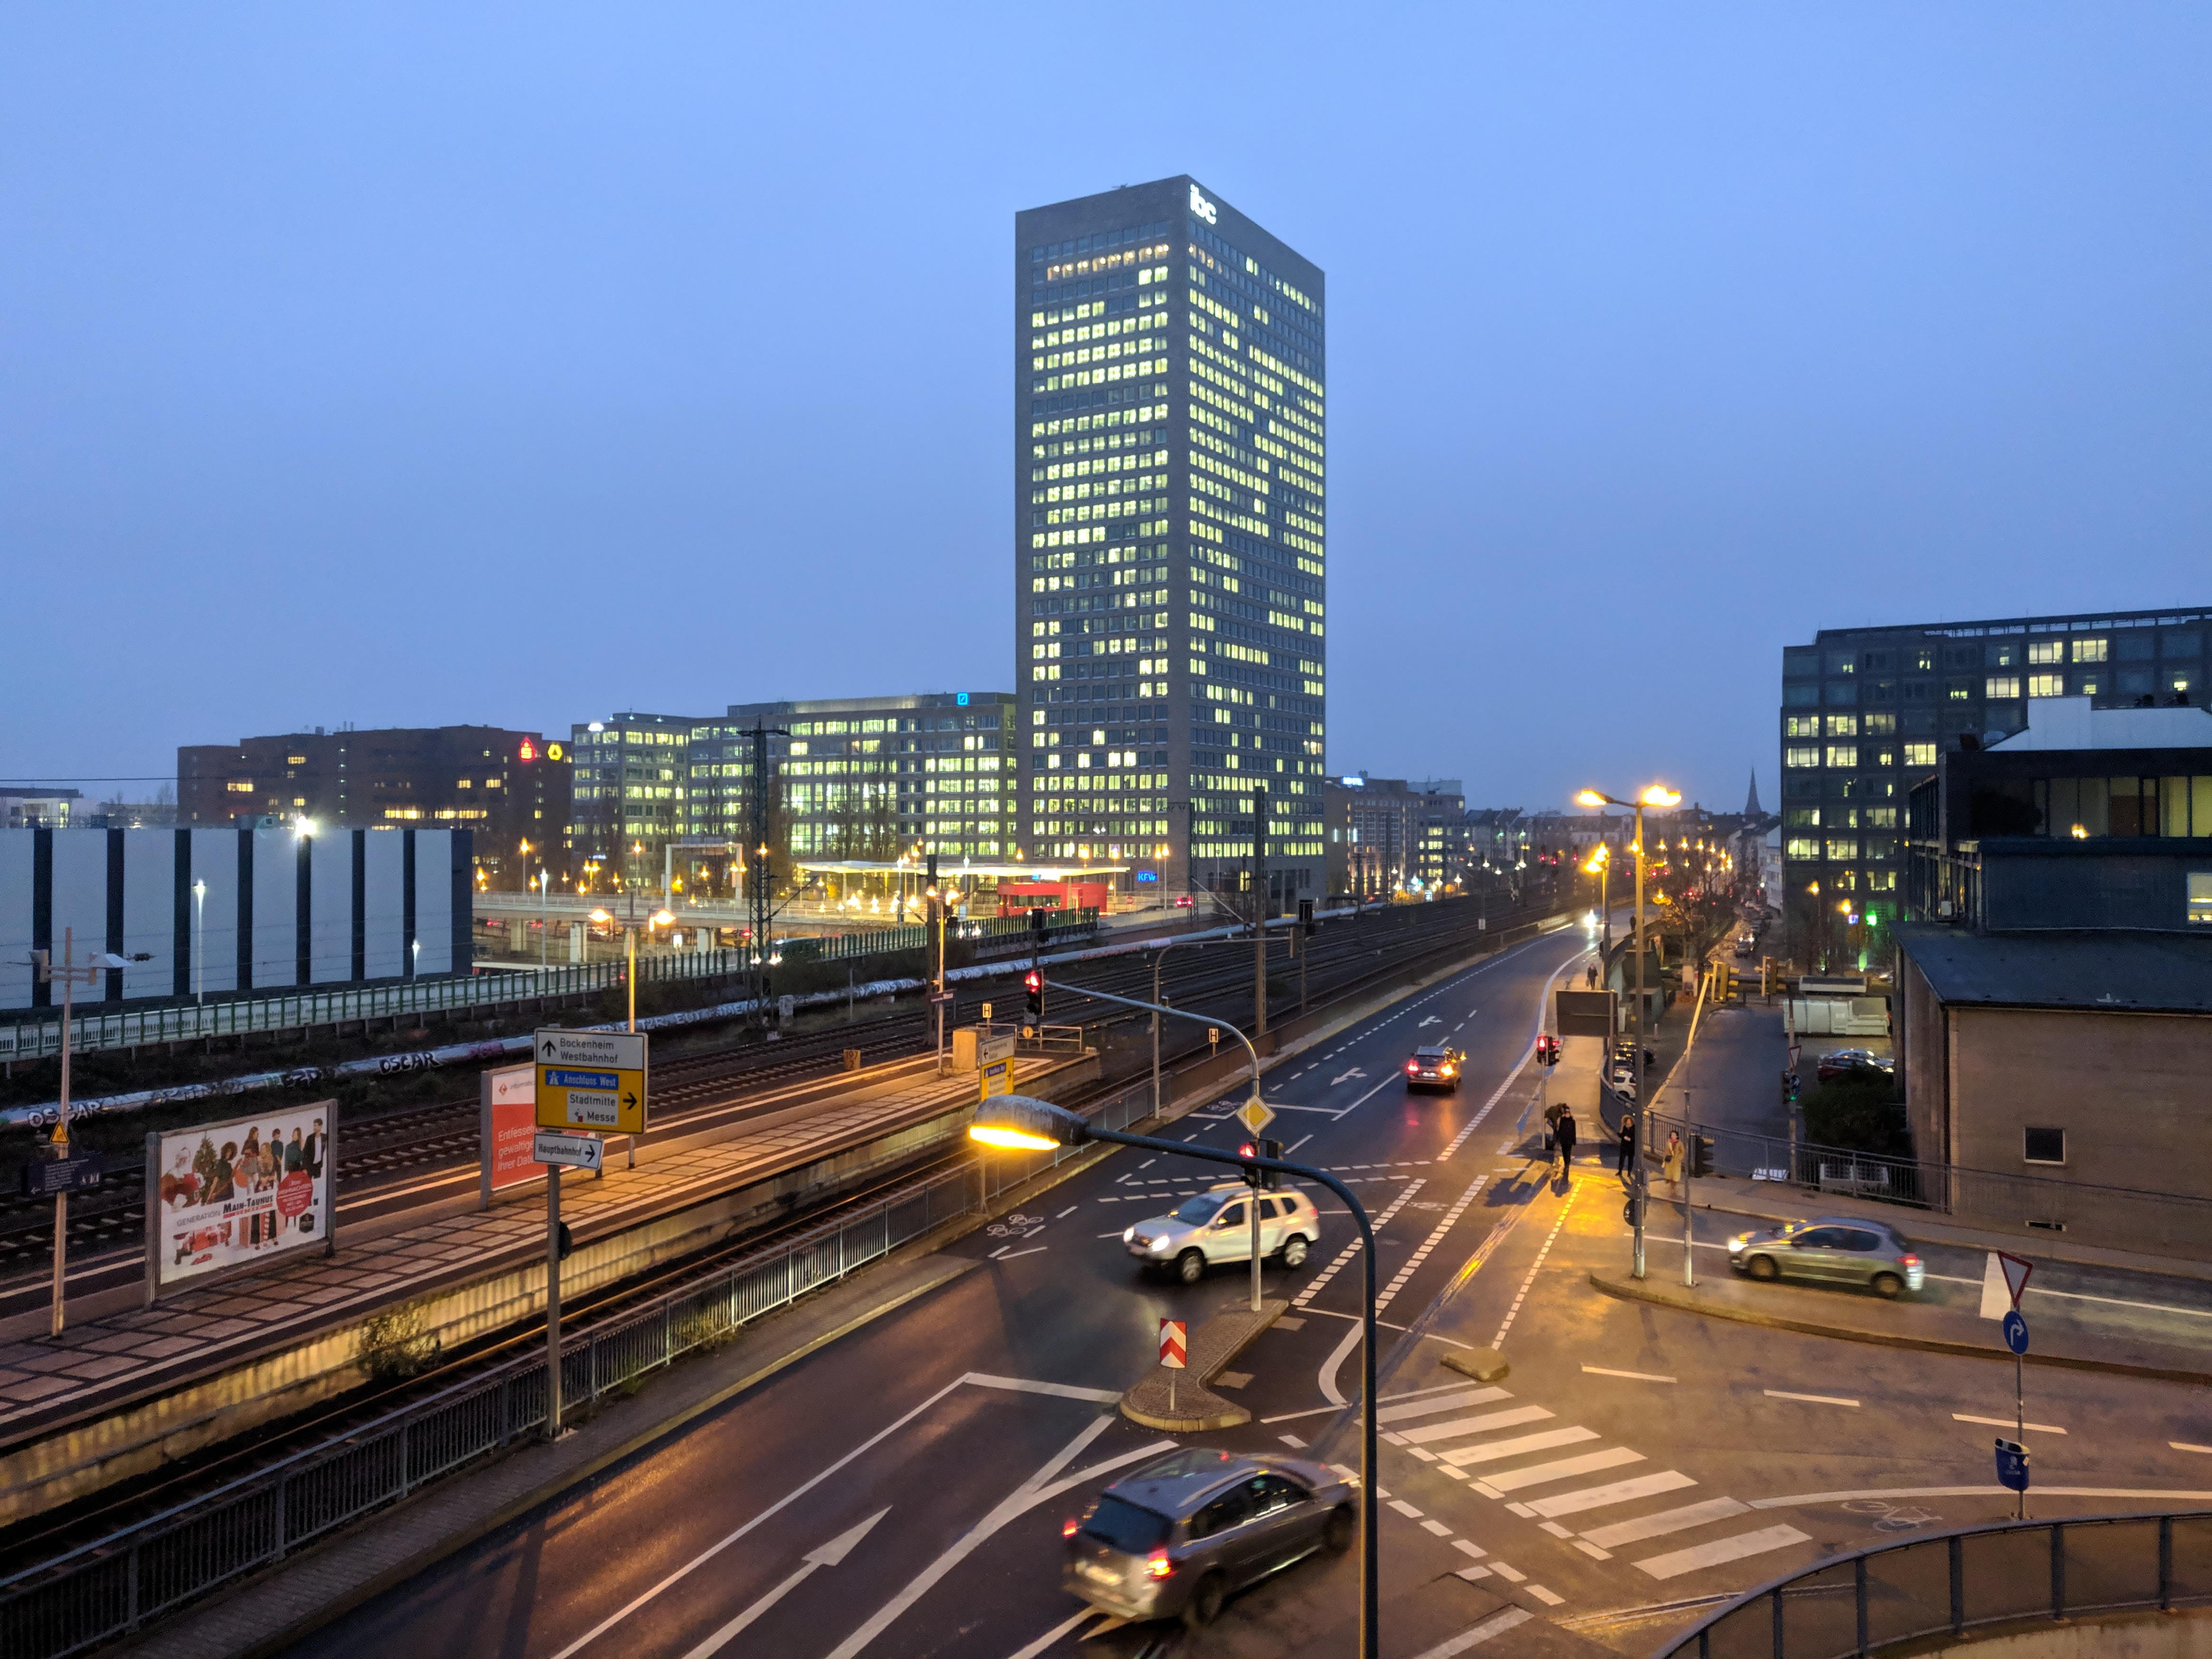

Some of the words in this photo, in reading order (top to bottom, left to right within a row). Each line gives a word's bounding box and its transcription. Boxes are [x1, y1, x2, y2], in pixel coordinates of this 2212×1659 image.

[1190, 183, 1217, 225] ibc
[984, 1005, 990, 1016] H
[1210, 1030, 1217, 1041] H
[560, 1038, 614, 1050] Bockenheim
[560, 1051, 618, 1063] Westbahnhof
[845, 1050, 858, 1060] 197
[380, 1052, 441, 1075] OSCAR
[849, 1060, 854, 1068] 2
[564, 1074, 597, 1086] Anschluss
[600, 1076, 616, 1087] West
[570, 1094, 616, 1106] Stadtmitte
[587, 1111, 615, 1122] Messe
[498, 1140, 534, 1159] gewaltige
[538, 1143, 582, 1156] Hauptbahnhof
[497, 1159, 515, 1172] Ihrer
[517, 1155, 534, 1167] Date
[223, 1194, 274, 1214] MAIN-TAUNUS
[176, 1210, 220, 1227] GENERATION
